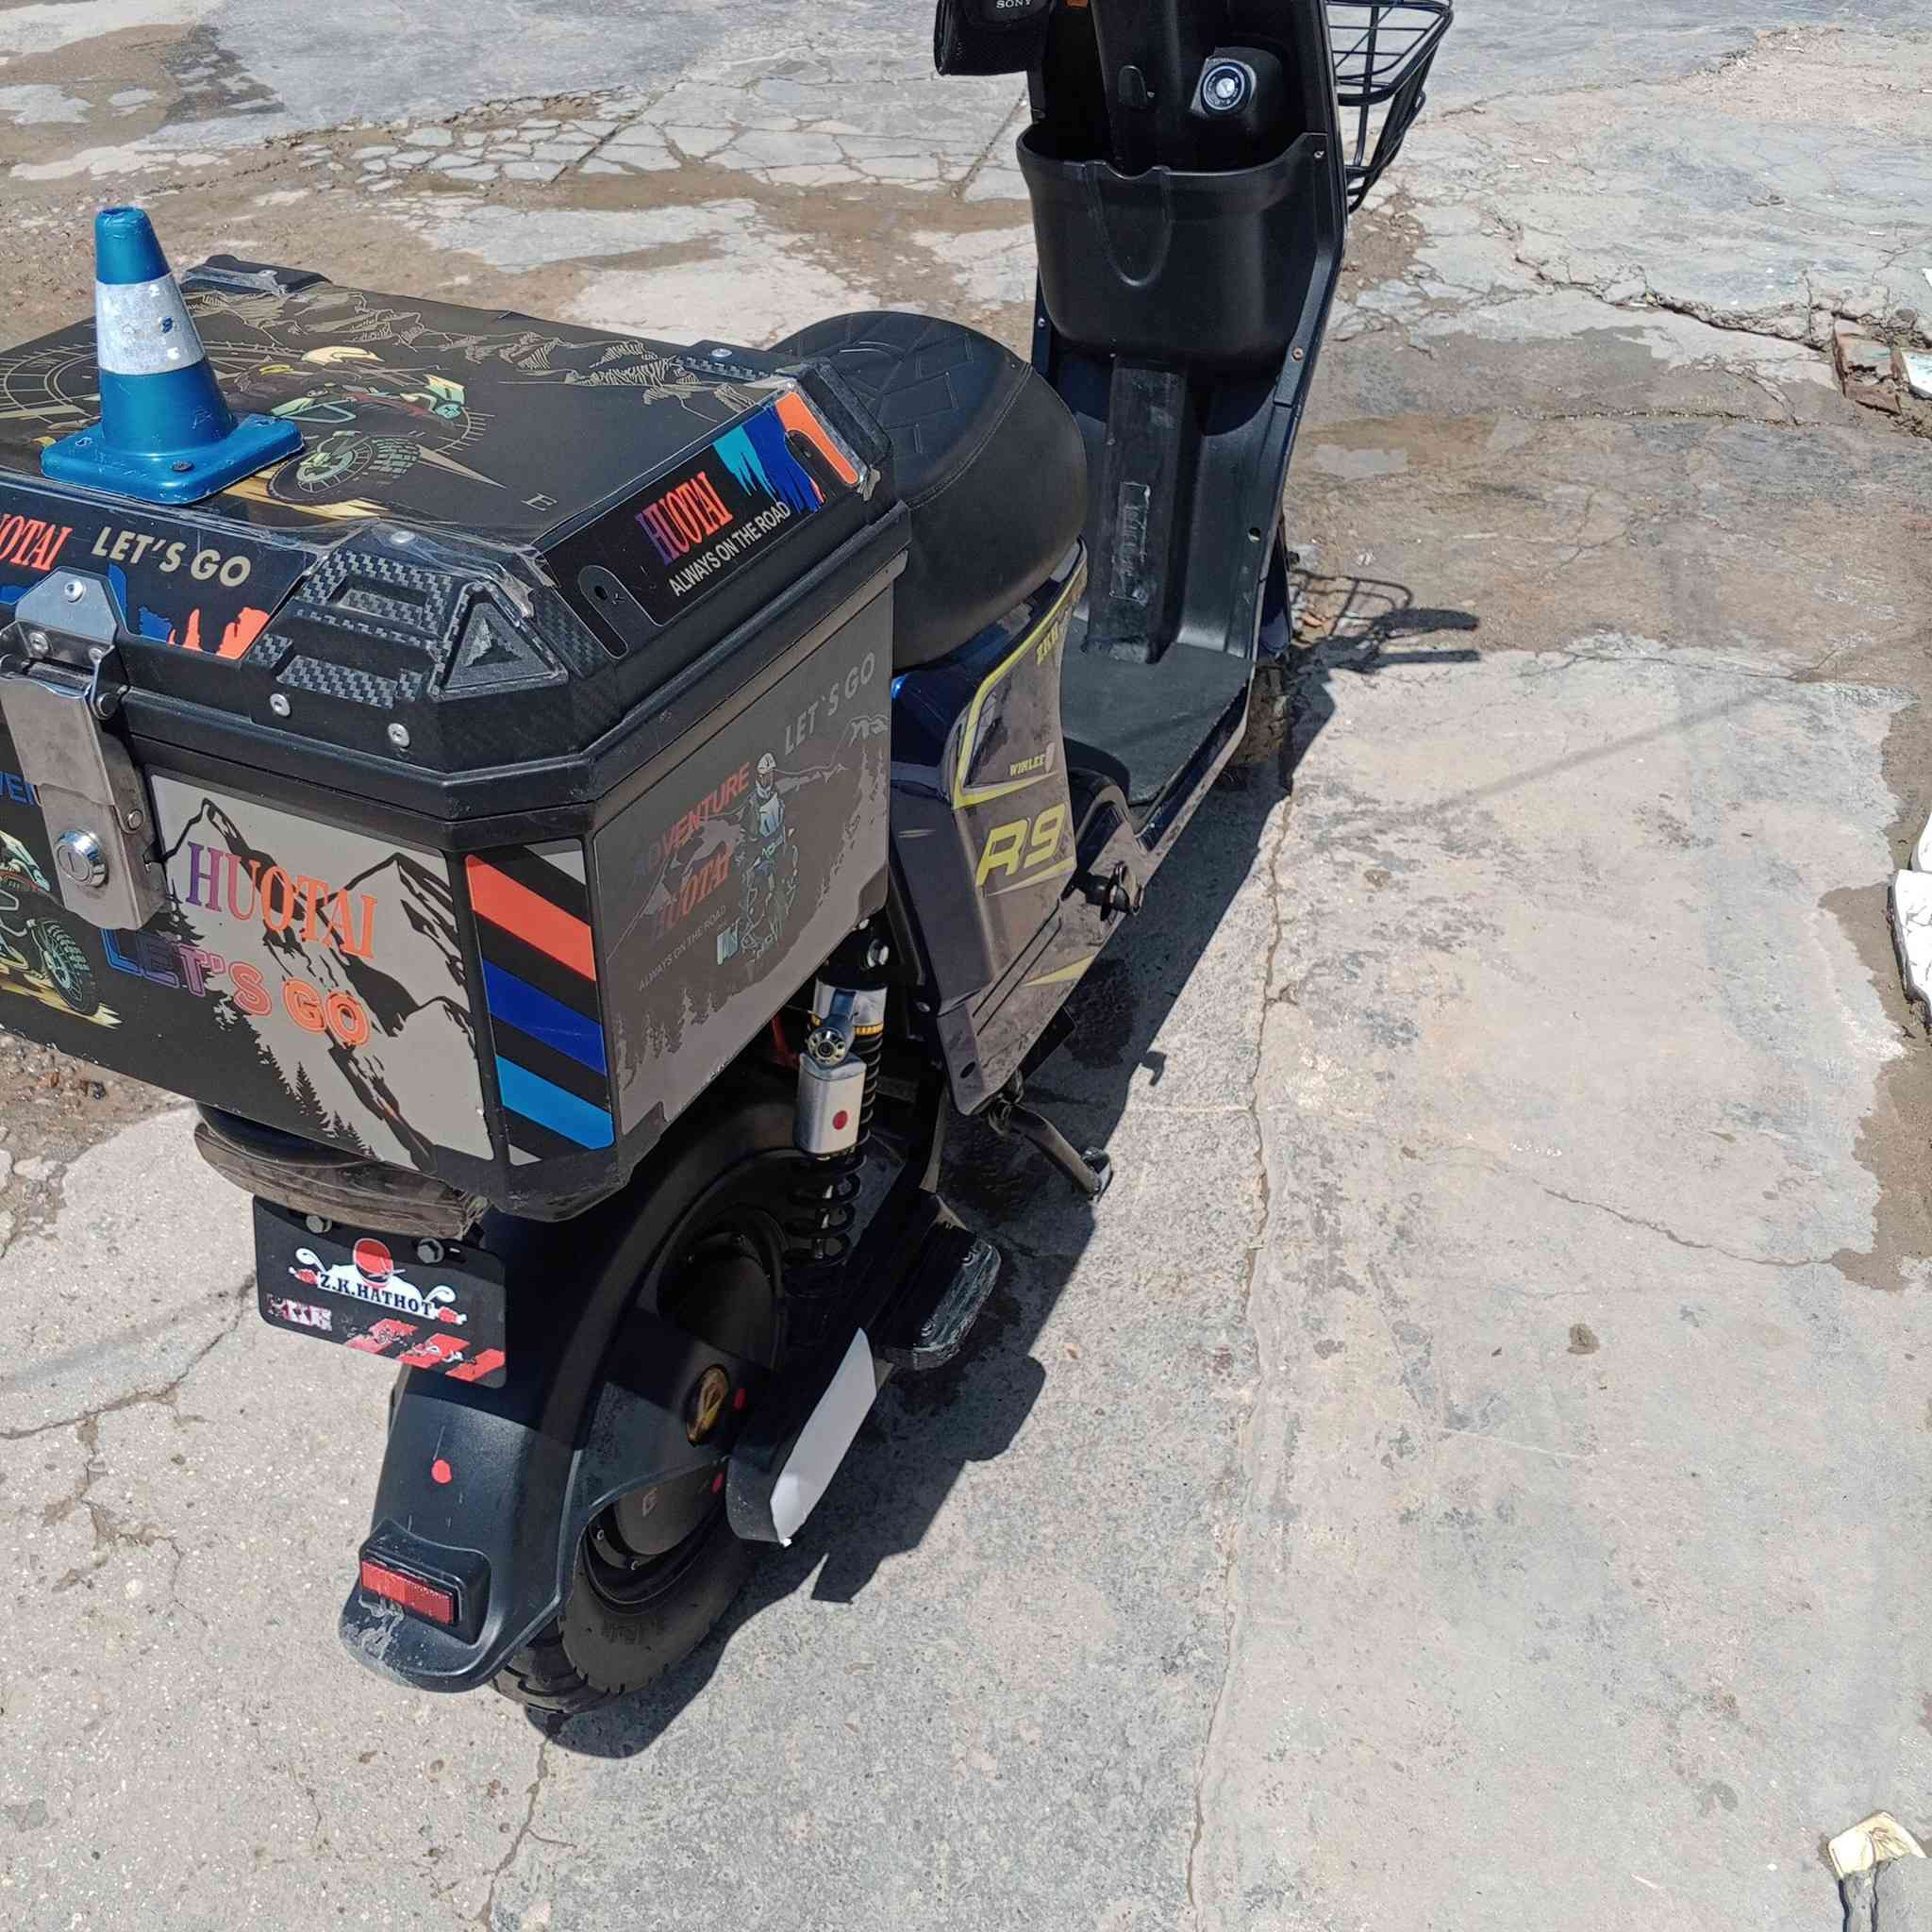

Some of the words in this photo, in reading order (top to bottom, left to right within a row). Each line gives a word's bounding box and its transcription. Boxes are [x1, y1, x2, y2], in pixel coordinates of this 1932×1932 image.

[996, 0, 1032, 8] SONY
[92, 526, 187, 573] LET'S
[191, 549, 251, 587] GO
[634, 471, 734, 567] HUOTAI
[667, 551, 720, 597] ALWAYS
[716, 535, 737, 561] ON
[732, 519, 761, 551] THE
[758, 501, 791, 535] ROAD
[845, 652, 875, 699] GO
[975, 803, 1066, 887] R9
[186, 841, 378, 959] HUOTAI
[100, 927, 273, 1017] LET'S
[283, 978, 371, 1047] GO
